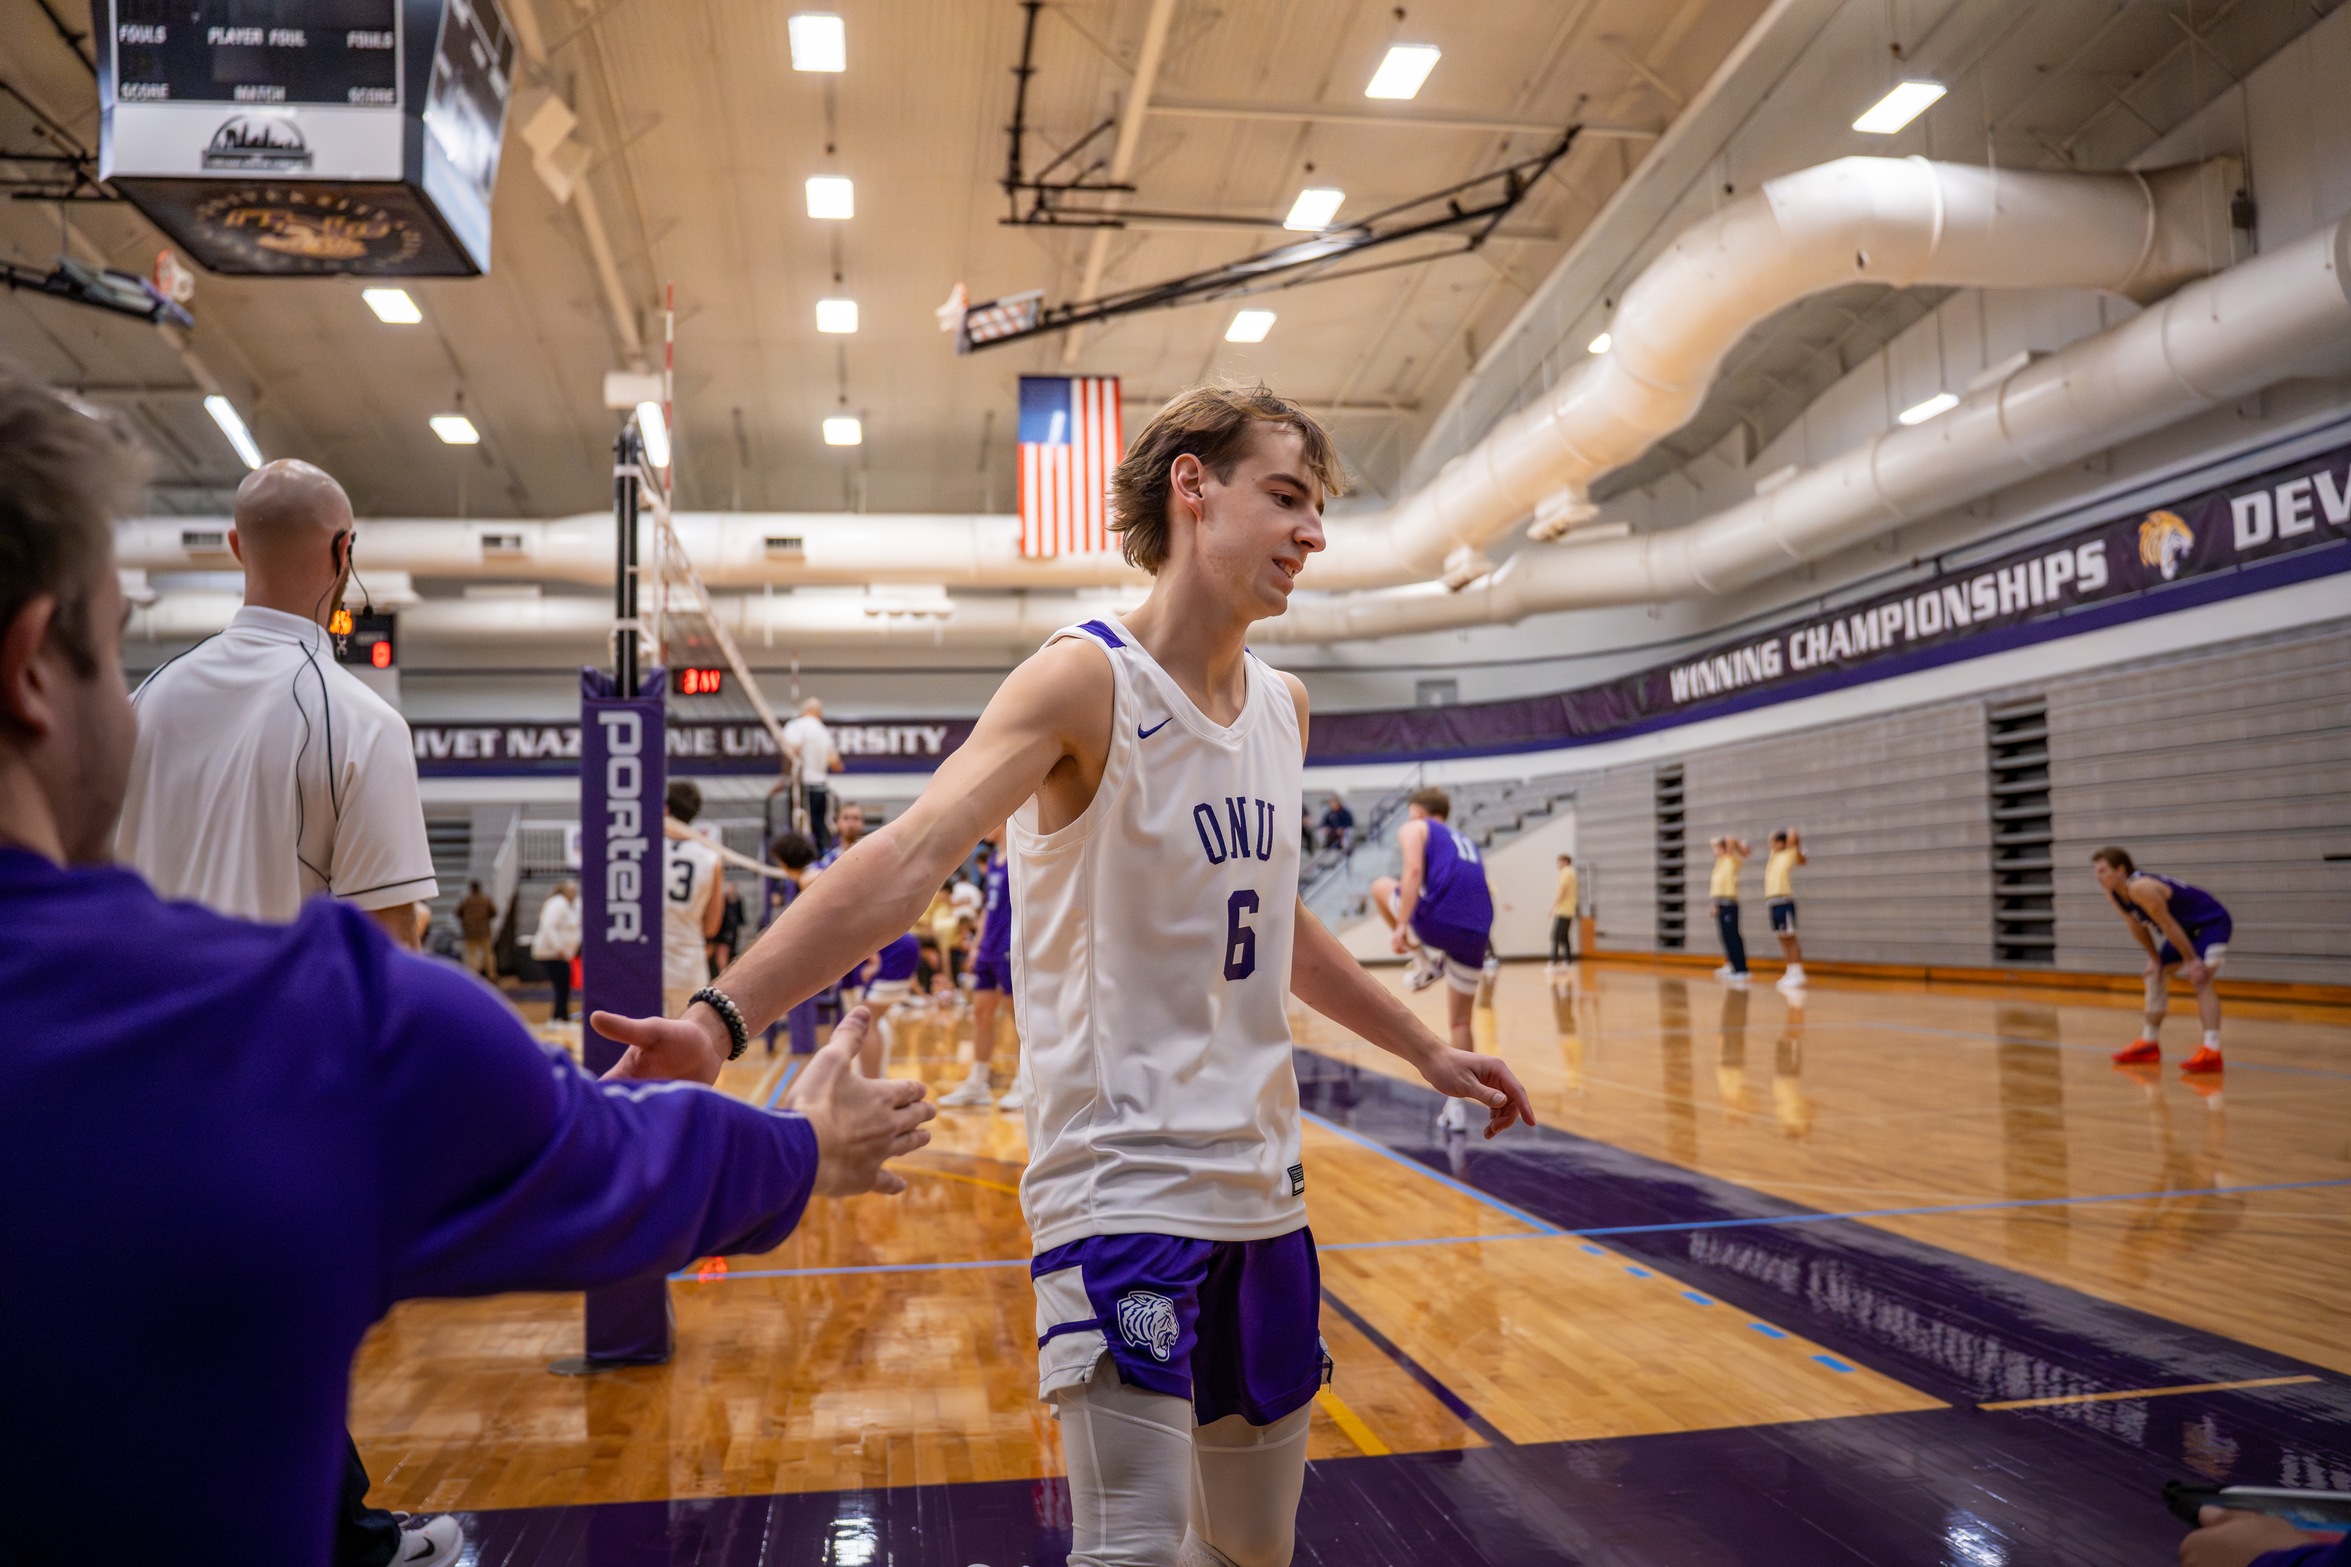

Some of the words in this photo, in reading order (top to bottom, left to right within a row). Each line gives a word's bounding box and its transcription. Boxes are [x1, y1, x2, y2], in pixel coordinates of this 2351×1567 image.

[119, 24, 167, 44] FOULS
[207, 26, 264, 46] PLAYER
[347, 30, 394, 49] FOULS
[1669, 638, 1784, 704] WINNING
[1789, 539, 2109, 671] CHAMPIONSHIPS
[413, 727, 502, 760] IVET
[506, 726, 717, 759] NAZNE
[1193, 796, 1275, 866] ONU
[668, 860, 694, 904] 3
[1223, 889, 1260, 981] 6
